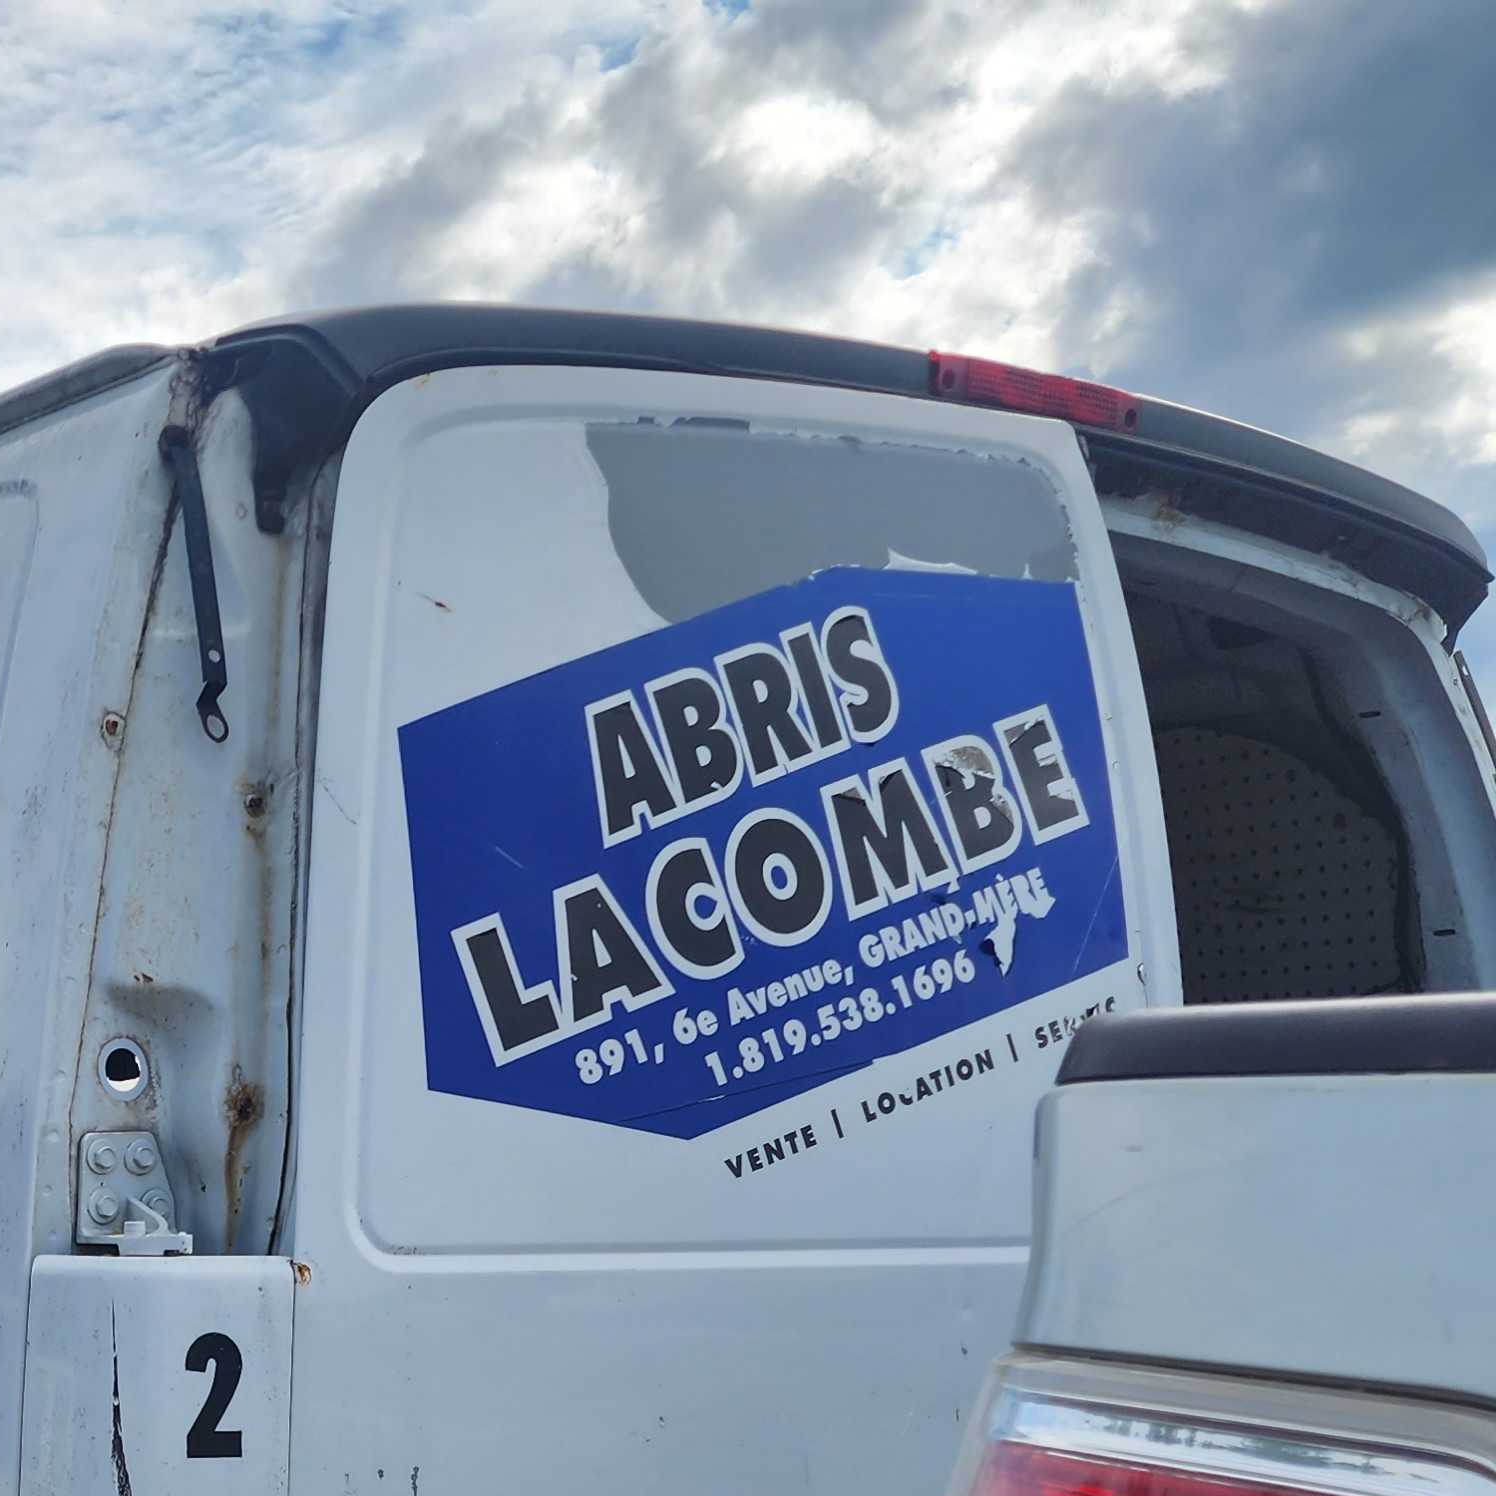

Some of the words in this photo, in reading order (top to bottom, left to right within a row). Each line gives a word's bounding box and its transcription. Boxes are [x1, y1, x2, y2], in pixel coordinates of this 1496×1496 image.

[584, 605, 900, 849] ABRIS
[451, 703, 1091, 1068] LACOMBE
[575, 1028, 665, 1085] 891,
[672, 1007, 719, 1046] 6e
[726, 956, 855, 1027] Avenue,
[703, 950, 976, 1087] 1.819.538.1696
[724, 1123, 818, 1179] VENTE
[185, 1332, 243, 1459] 2
